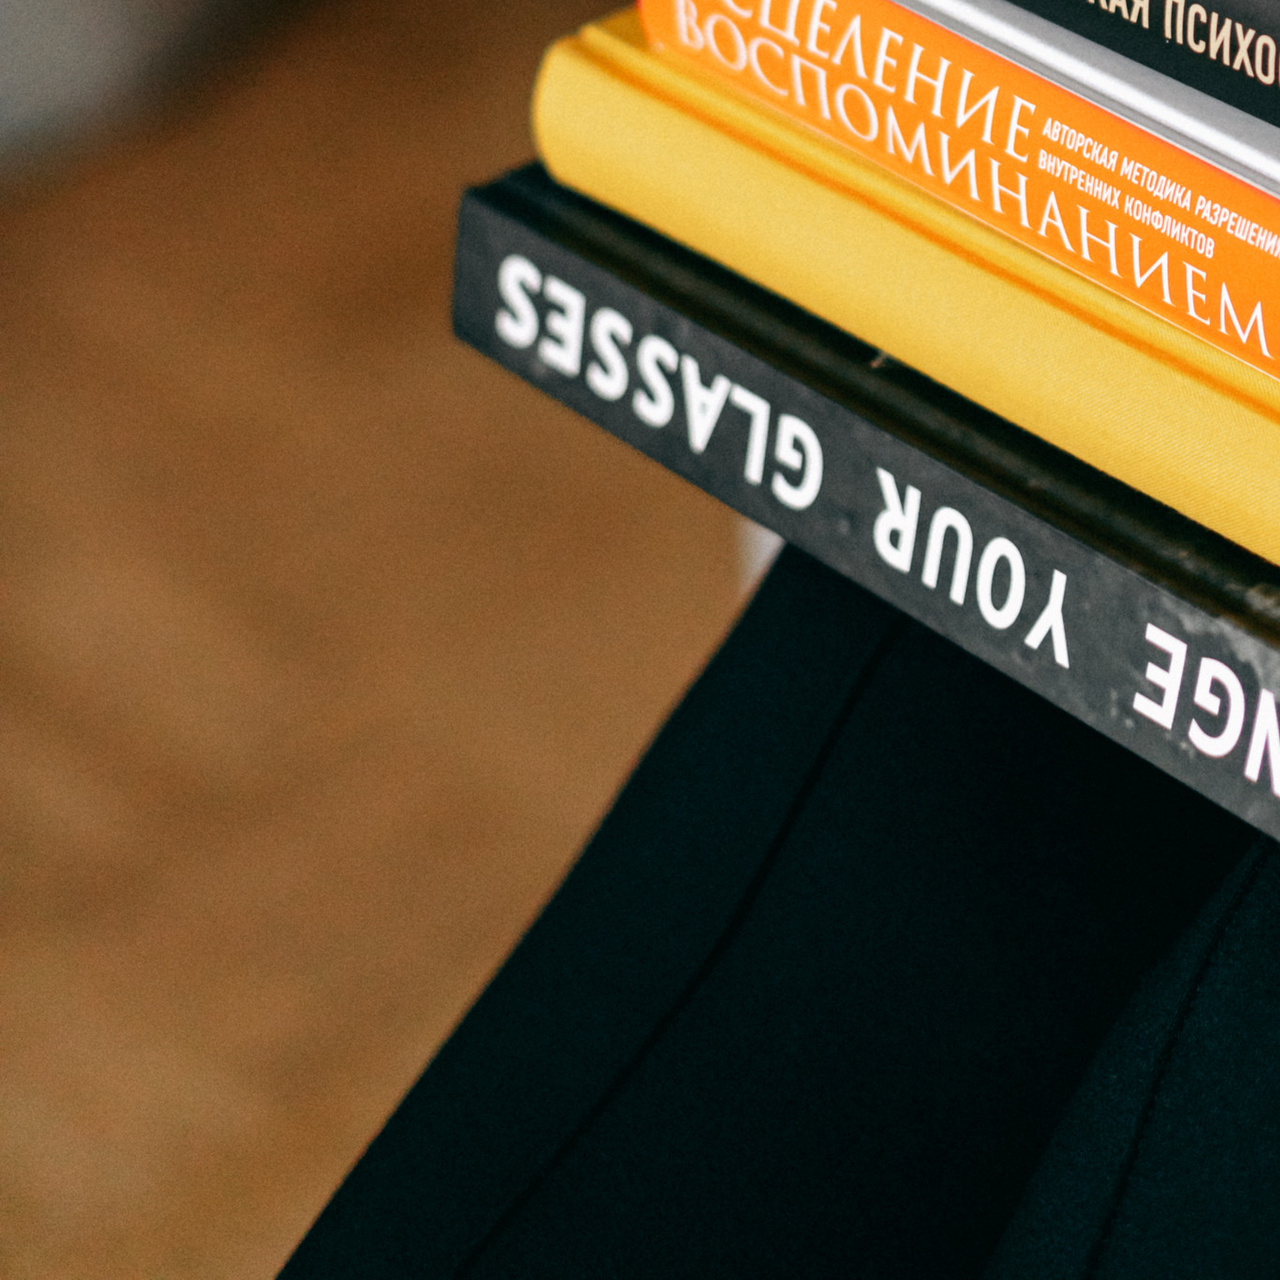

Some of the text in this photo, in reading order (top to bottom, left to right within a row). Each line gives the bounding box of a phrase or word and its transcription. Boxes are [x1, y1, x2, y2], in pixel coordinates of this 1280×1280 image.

[1038, 149, 1215, 258] ВНУТРЕННИХ КОНФЛИКТОВ
[1042, 117, 1118, 172] АВТОРСКАЯ
[1120, 156, 1191, 211] МЕТОДИКА
[495, 253, 824, 510] GLASSES
[872, 466, 1070, 669] YOUR
